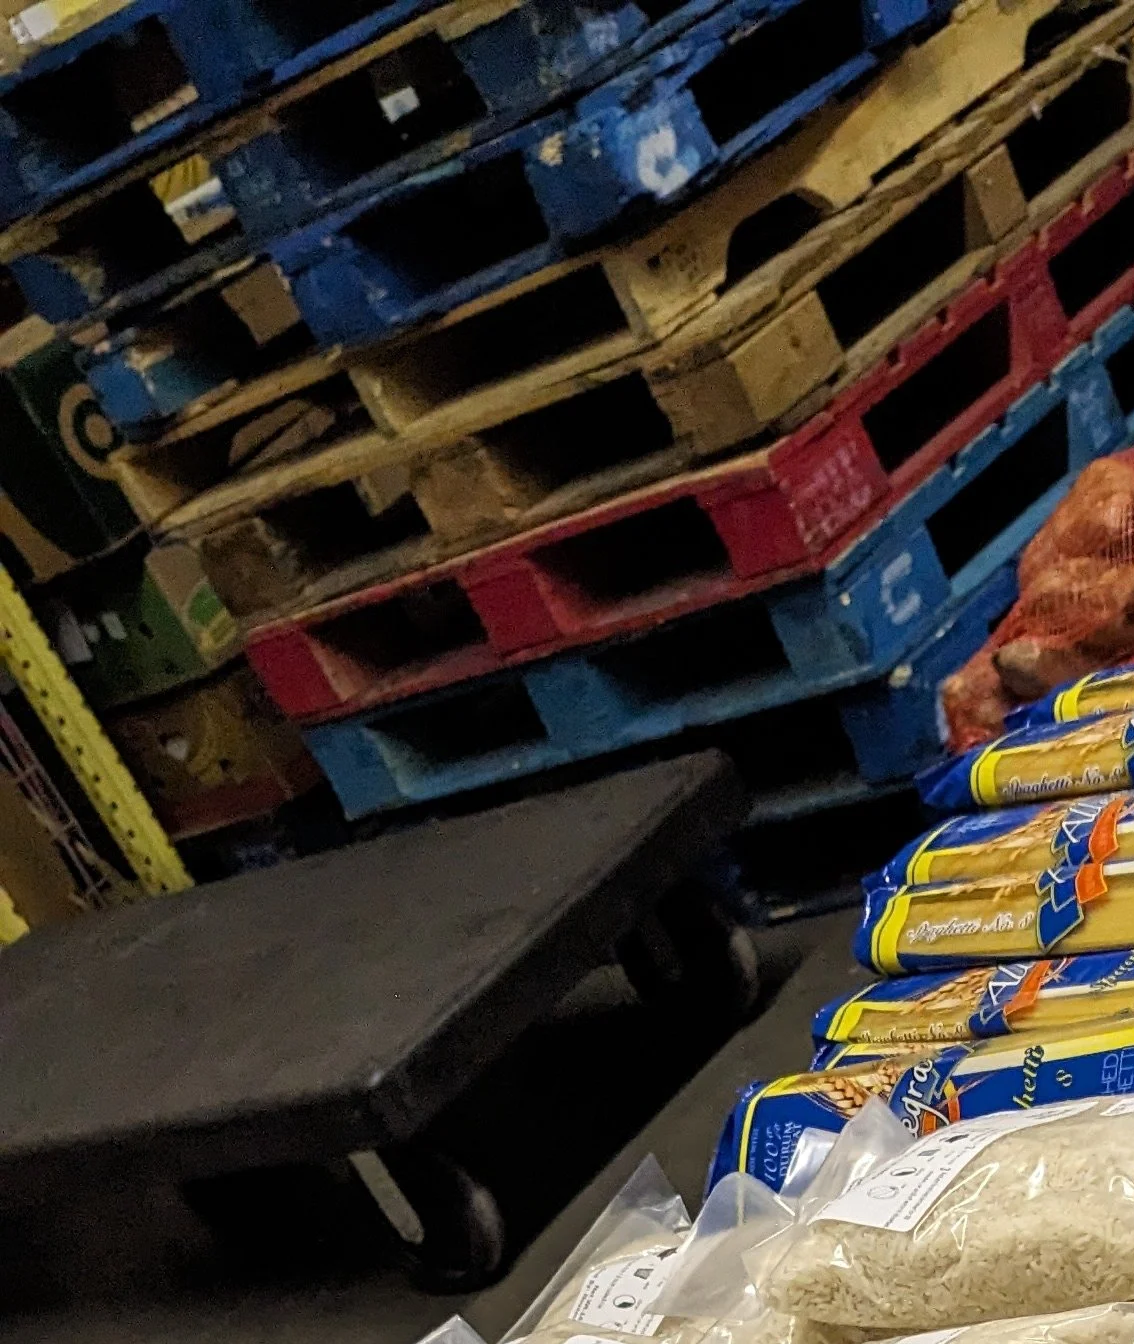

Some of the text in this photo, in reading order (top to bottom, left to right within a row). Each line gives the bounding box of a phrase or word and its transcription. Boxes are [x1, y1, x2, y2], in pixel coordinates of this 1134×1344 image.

[1003, 770, 1073, 798] Spaghetti
[907, 916, 979, 945] Spaghetti
[900, 1057, 946, 1139] egra
